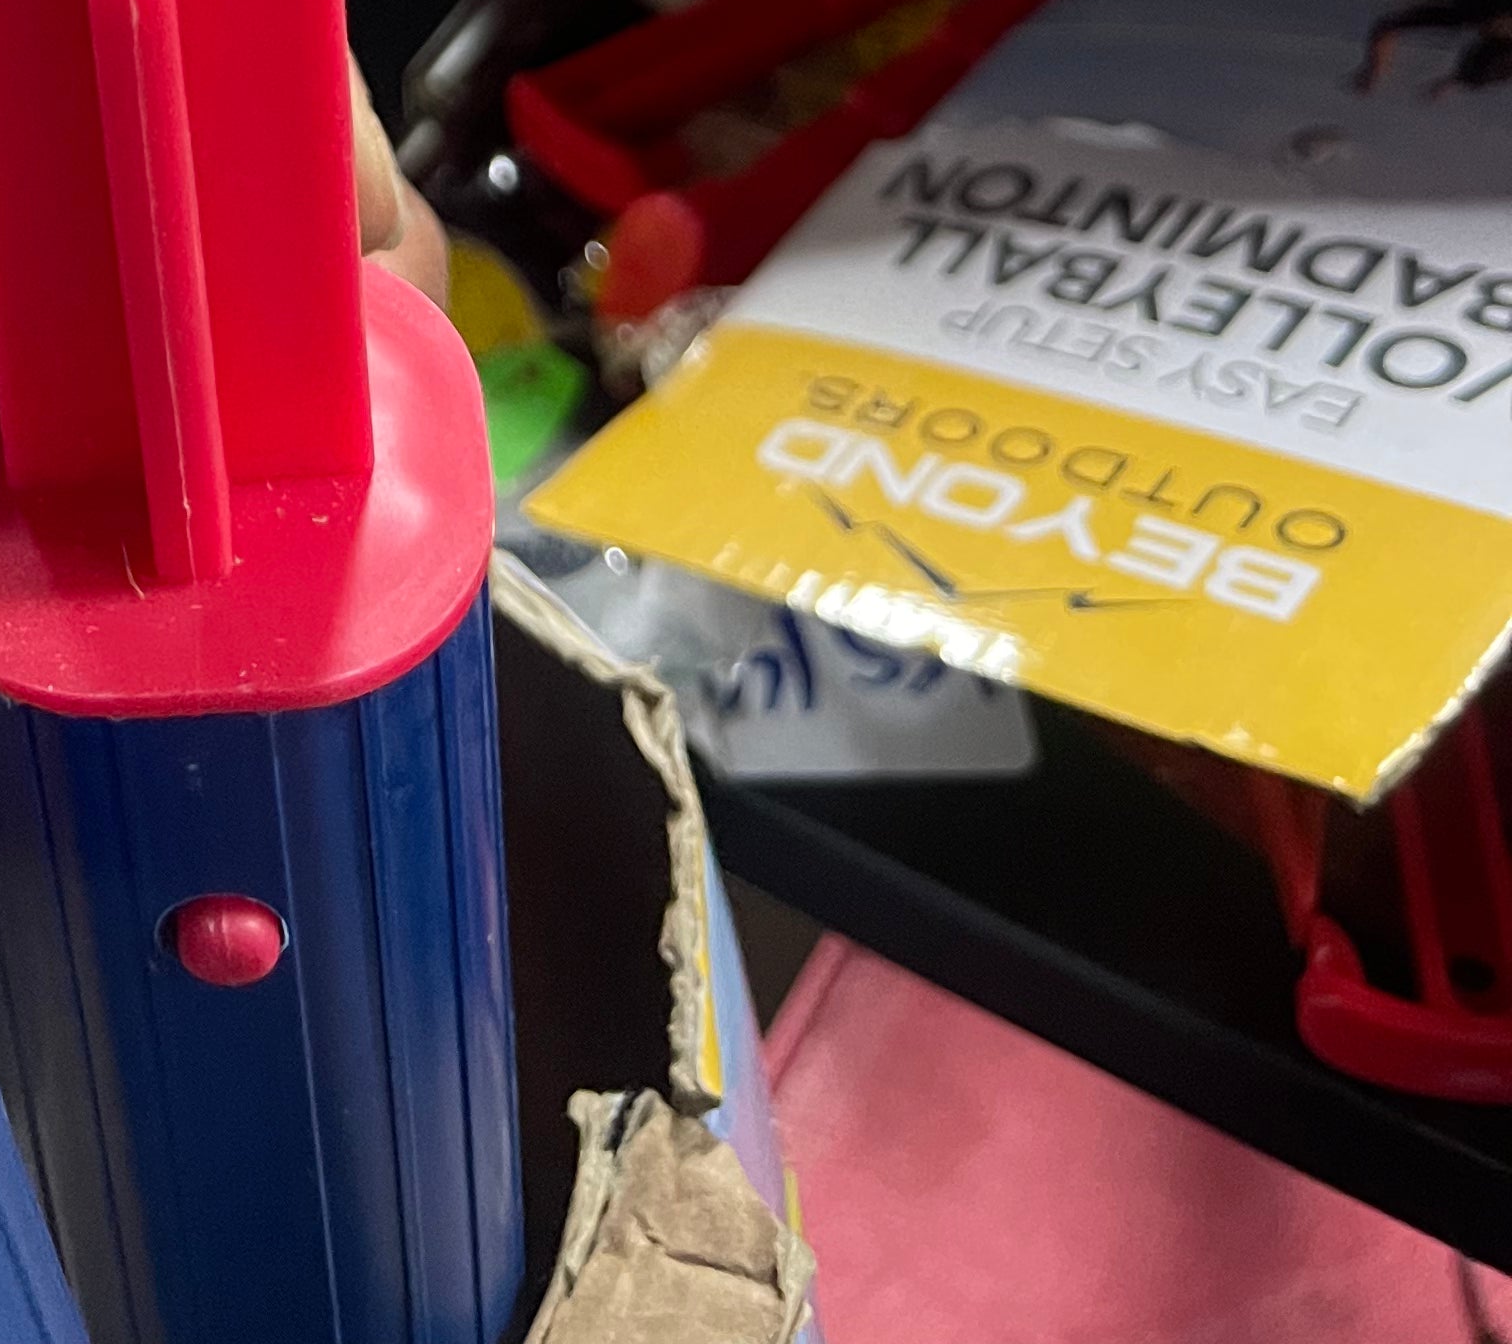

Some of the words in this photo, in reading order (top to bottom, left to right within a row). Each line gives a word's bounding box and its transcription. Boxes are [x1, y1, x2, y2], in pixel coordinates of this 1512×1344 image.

[943, 302, 1154, 372] SETUP
[1158, 350, 1366, 429] EASY
[758, 418, 1322, 622] BEYOND
[808, 372, 1347, 552] OUTDOORS
